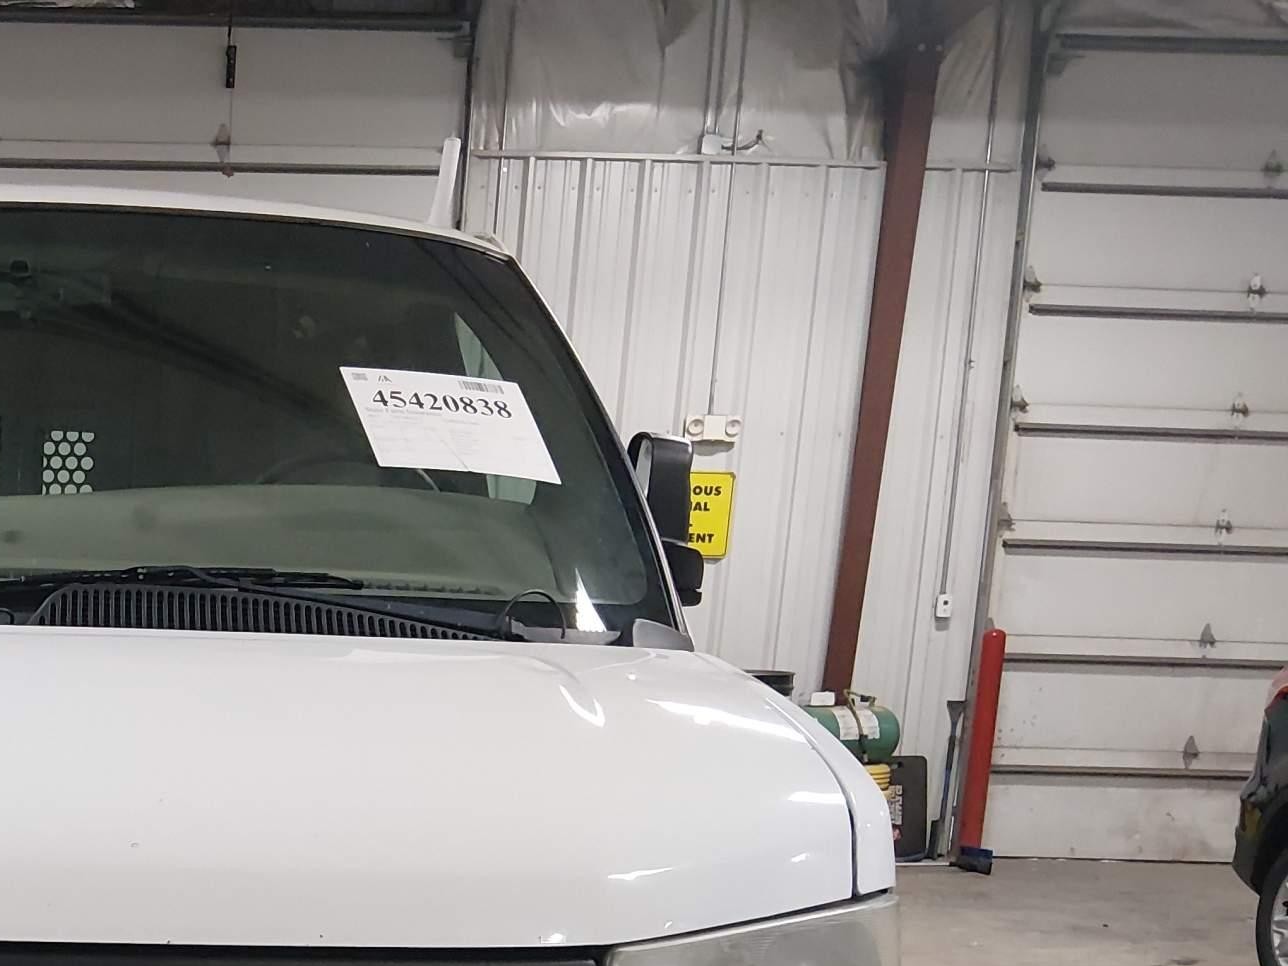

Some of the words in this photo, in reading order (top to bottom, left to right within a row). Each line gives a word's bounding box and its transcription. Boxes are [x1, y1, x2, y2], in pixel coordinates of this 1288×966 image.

[372, 390, 513, 419] 45420838
[692, 485, 723, 496] OUS
[690, 501, 710, 512] AL
[688, 532, 715, 544] ENT
